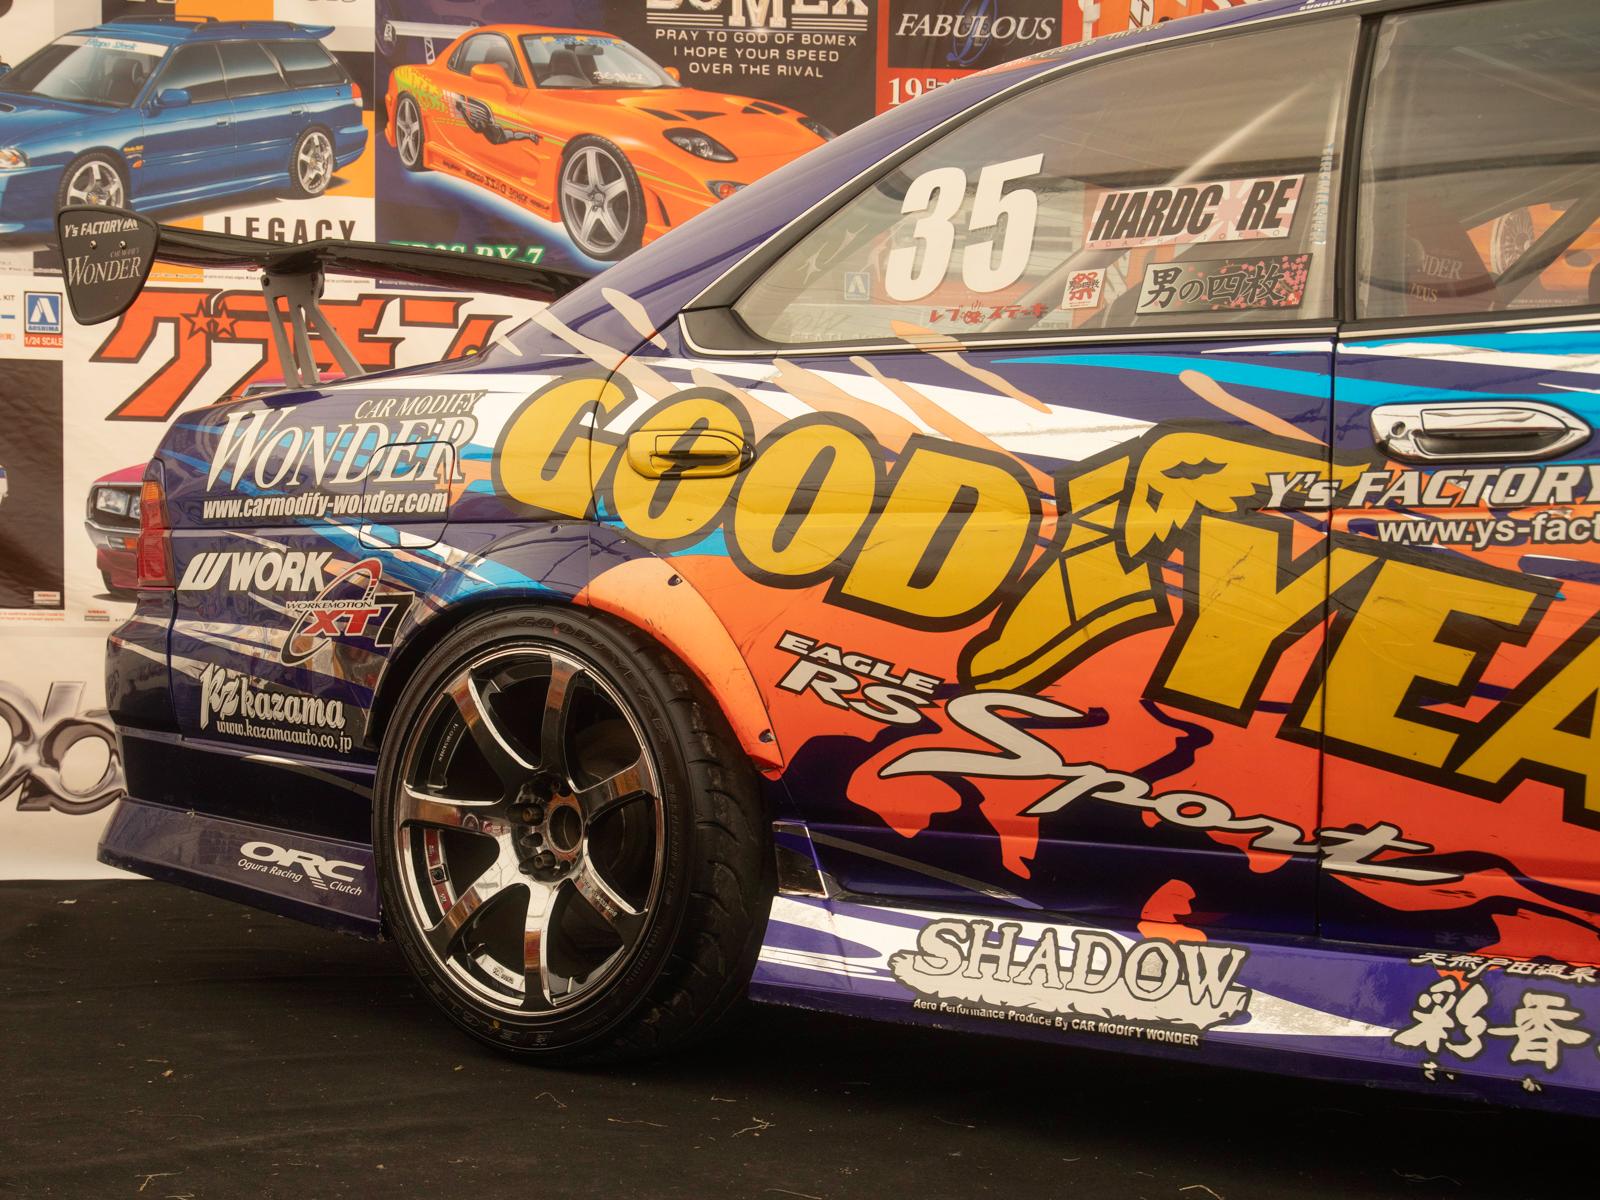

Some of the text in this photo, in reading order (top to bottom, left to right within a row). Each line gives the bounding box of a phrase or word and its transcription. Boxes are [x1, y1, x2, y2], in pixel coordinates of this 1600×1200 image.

[655, 29, 857, 46] PRAY TO GOD OF BOMEX
[896, 13, 1056, 40] FABULOUS
[673, 46, 839, 62] I HOPE YOUR SPEED
[689, 62, 823, 78] OVER THE RIVAL
[64, 218, 123, 238] Y's FACTORY
[884, 152, 1045, 302] 35
[67, 255, 142, 287] WONDER
[1140, 263, 1286, 309] 男の四枚
[25, 336, 63, 346] 1/24 SCALE
[354, 391, 484, 420] CAR MODIFY
[206, 405, 479, 493] WONDER
[202, 490, 449, 519] www.carmodify-wonder.com
[493, 375, 1038, 633] GOOD
[1264, 471, 1343, 509] Y's
[228, 551, 333, 591] WORK
[776, 632, 943, 696] EAGLE
[241, 676, 346, 730] kazama
[777, 658, 932, 726] RS
[215, 720, 353, 752] www.kazamaauto.co.jp
[880, 691, 1465, 882] Sport
[237, 858, 363, 896] Ogura Racing Clutch
[239, 841, 365, 883] ORC
[911, 920, 1247, 1009] SHADOW
[913, 998, 1199, 1047] Aero Performance Produce By CAR MODIFY WONDER
